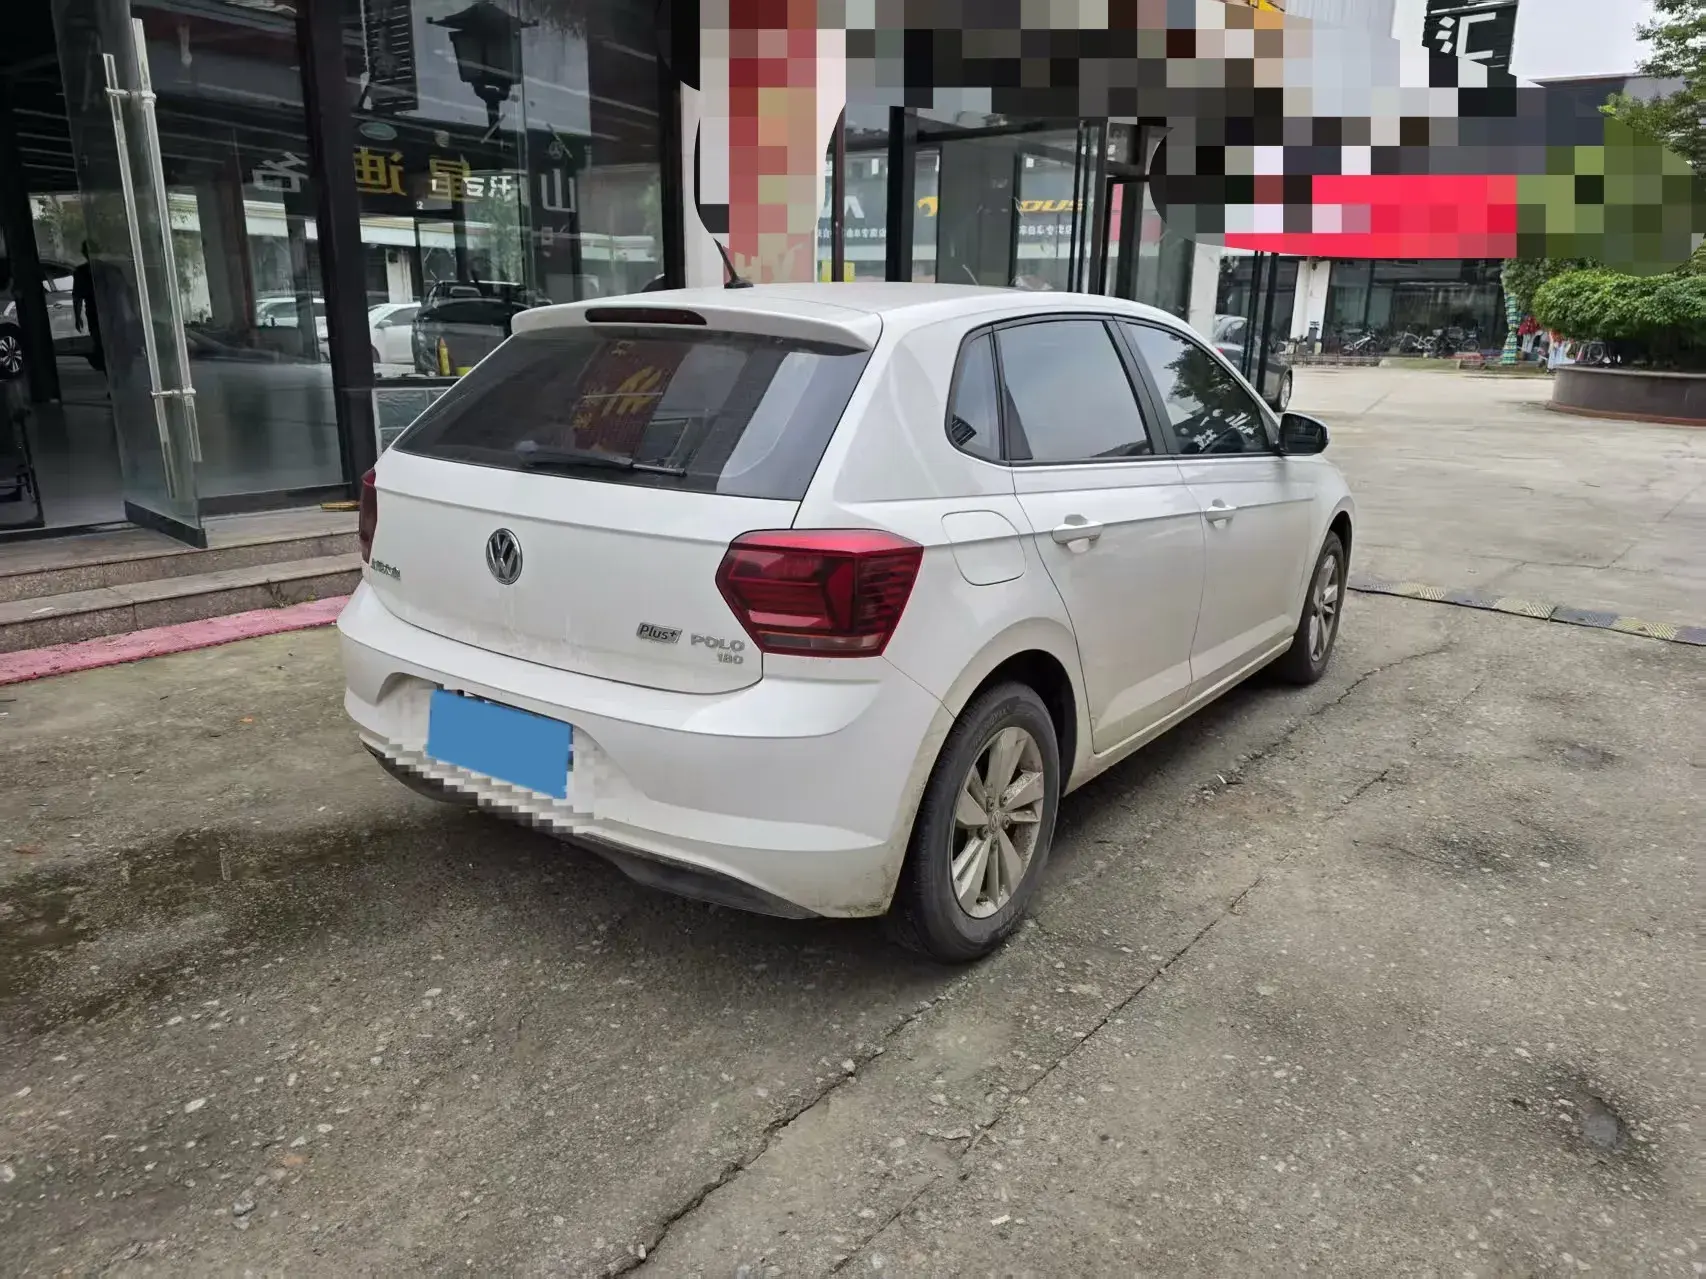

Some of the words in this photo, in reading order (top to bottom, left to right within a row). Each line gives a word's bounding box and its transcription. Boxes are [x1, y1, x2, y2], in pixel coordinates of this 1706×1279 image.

[1435, 12, 1497, 60] 汇
[638, 623, 678, 641] Plus+
[690, 633, 746, 652] POLO
[717, 652, 744, 665] 180
